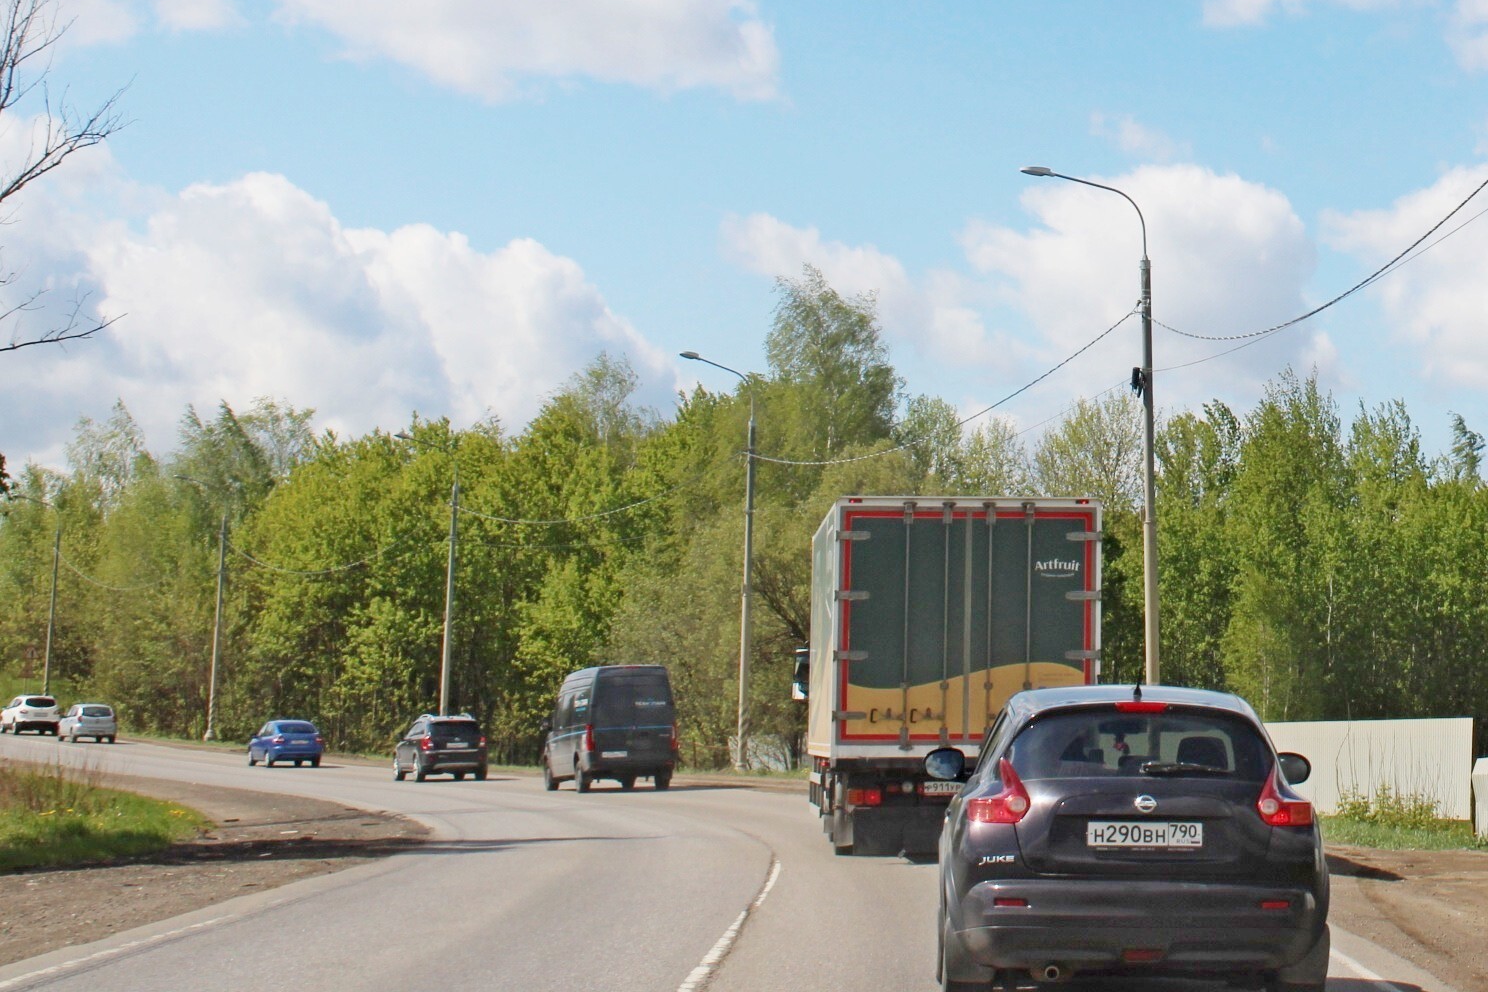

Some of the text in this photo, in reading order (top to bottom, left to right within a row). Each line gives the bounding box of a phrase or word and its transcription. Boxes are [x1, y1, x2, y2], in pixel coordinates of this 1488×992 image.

[1034, 558, 1080, 571] Artfruit
[1094, 824, 1197, 843] Н290ВН 790
[978, 855, 1015, 866] JUKE
